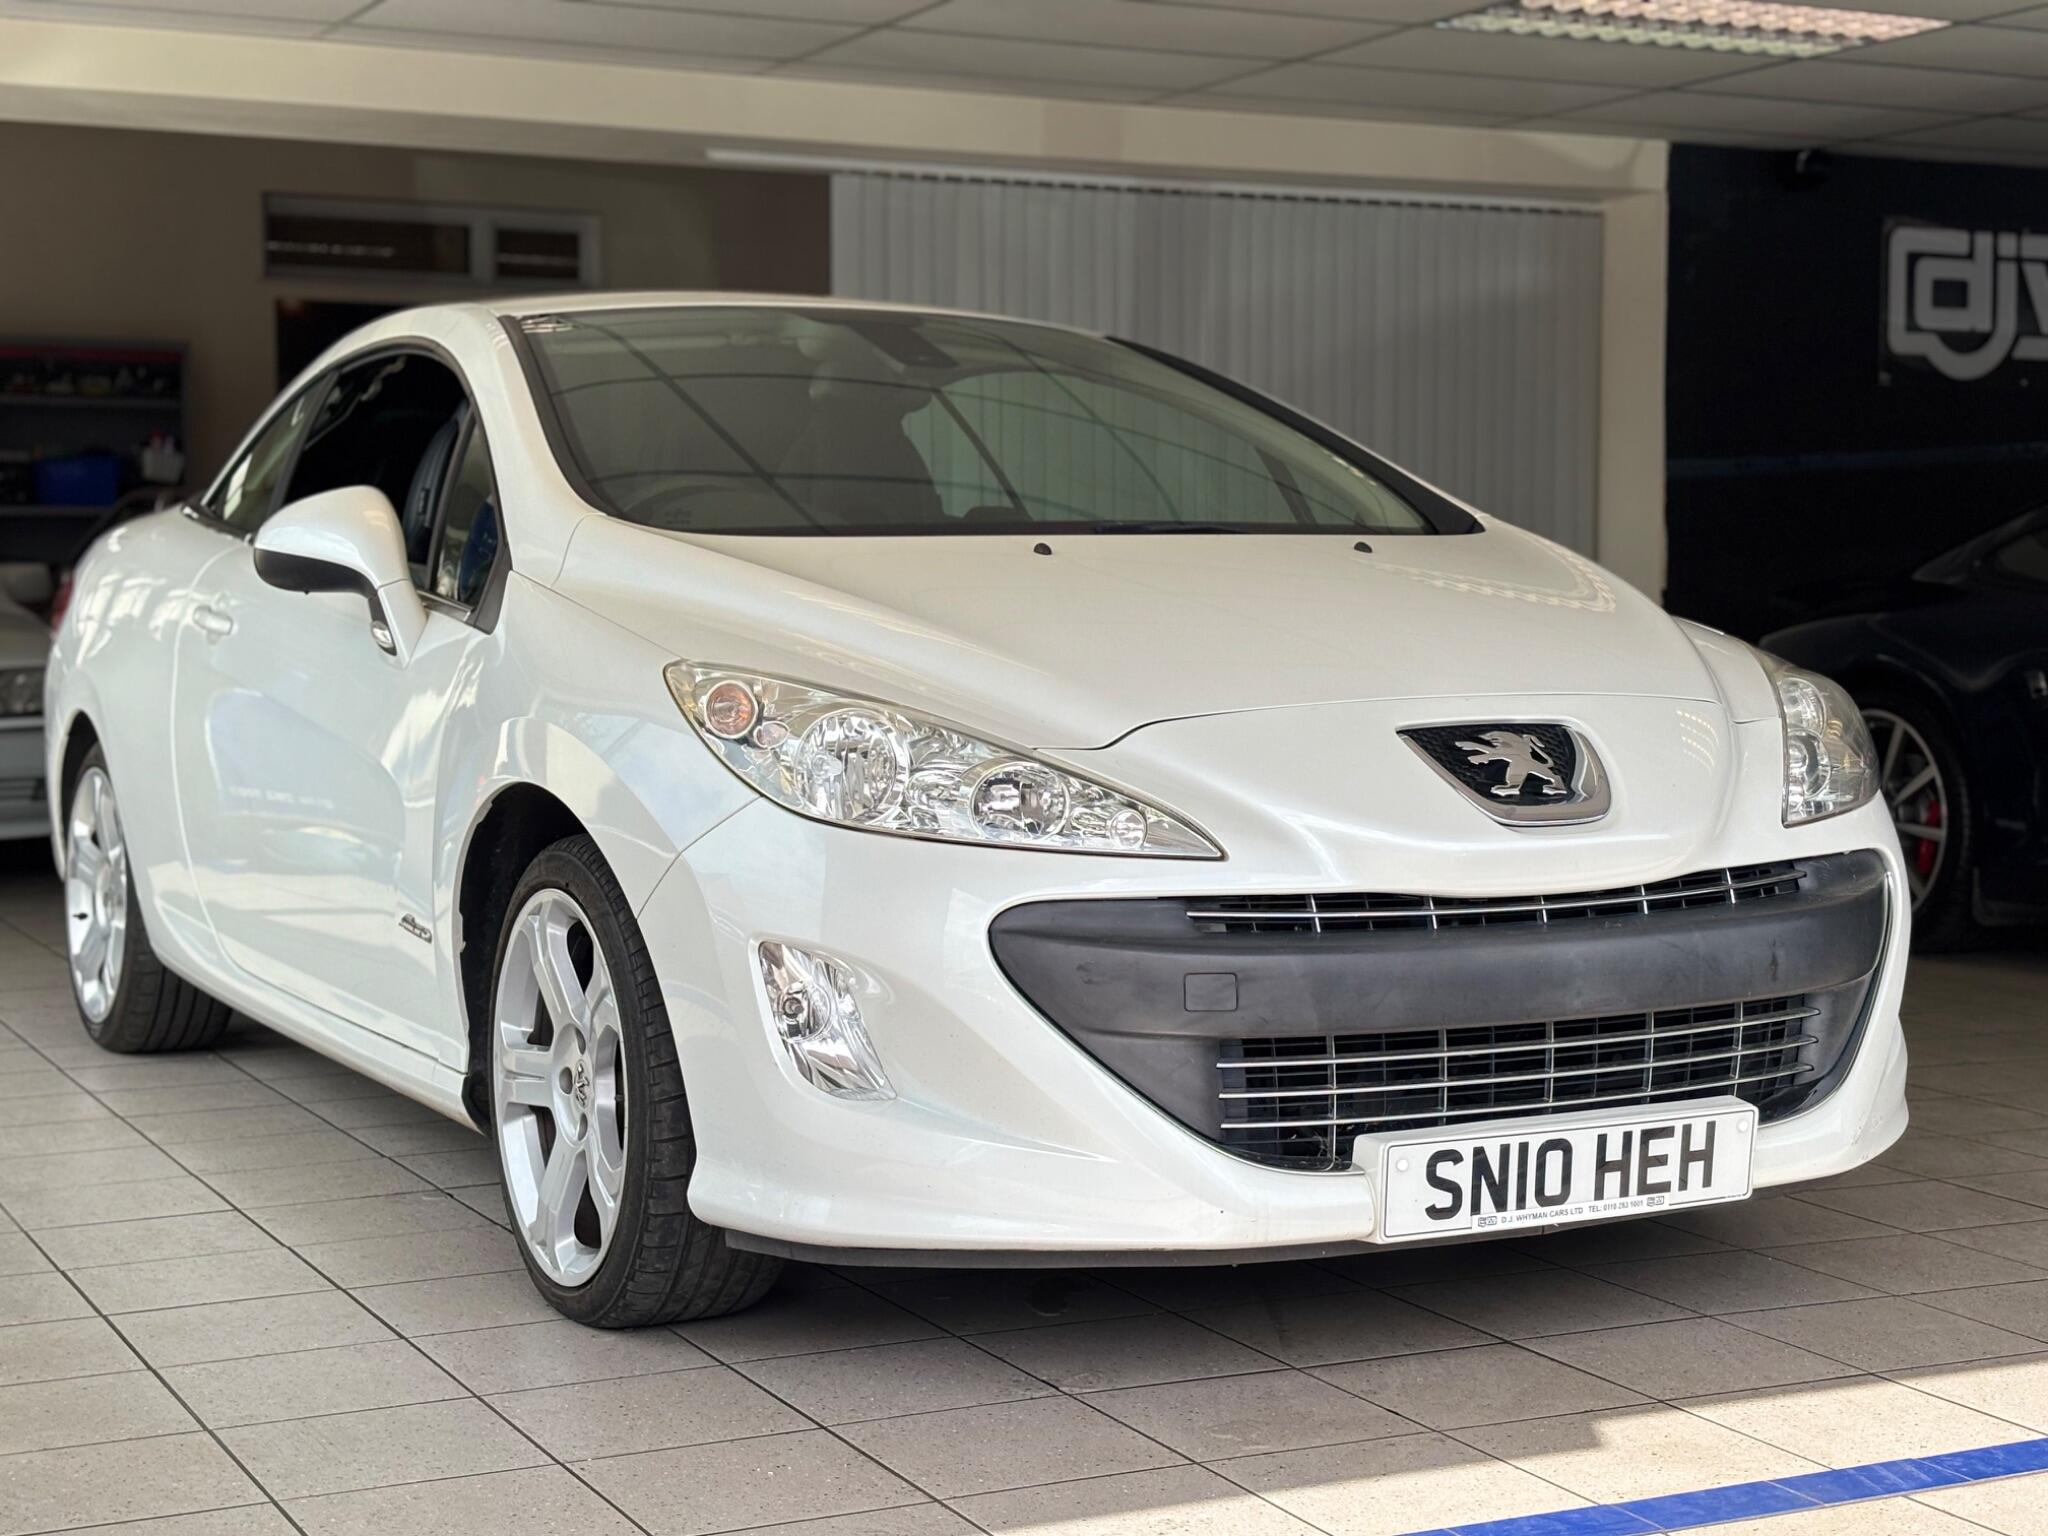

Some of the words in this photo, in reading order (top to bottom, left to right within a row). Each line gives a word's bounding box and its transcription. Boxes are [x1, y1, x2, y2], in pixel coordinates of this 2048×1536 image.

[1424, 1138, 1574, 1221] SN10
[1593, 1120, 1717, 1198] HEH
[1516, 1211, 1548, 1223] WHYMAN
[1549, 1208, 1569, 1217] CARS
[1570, 1206, 1584, 1216] LTD
